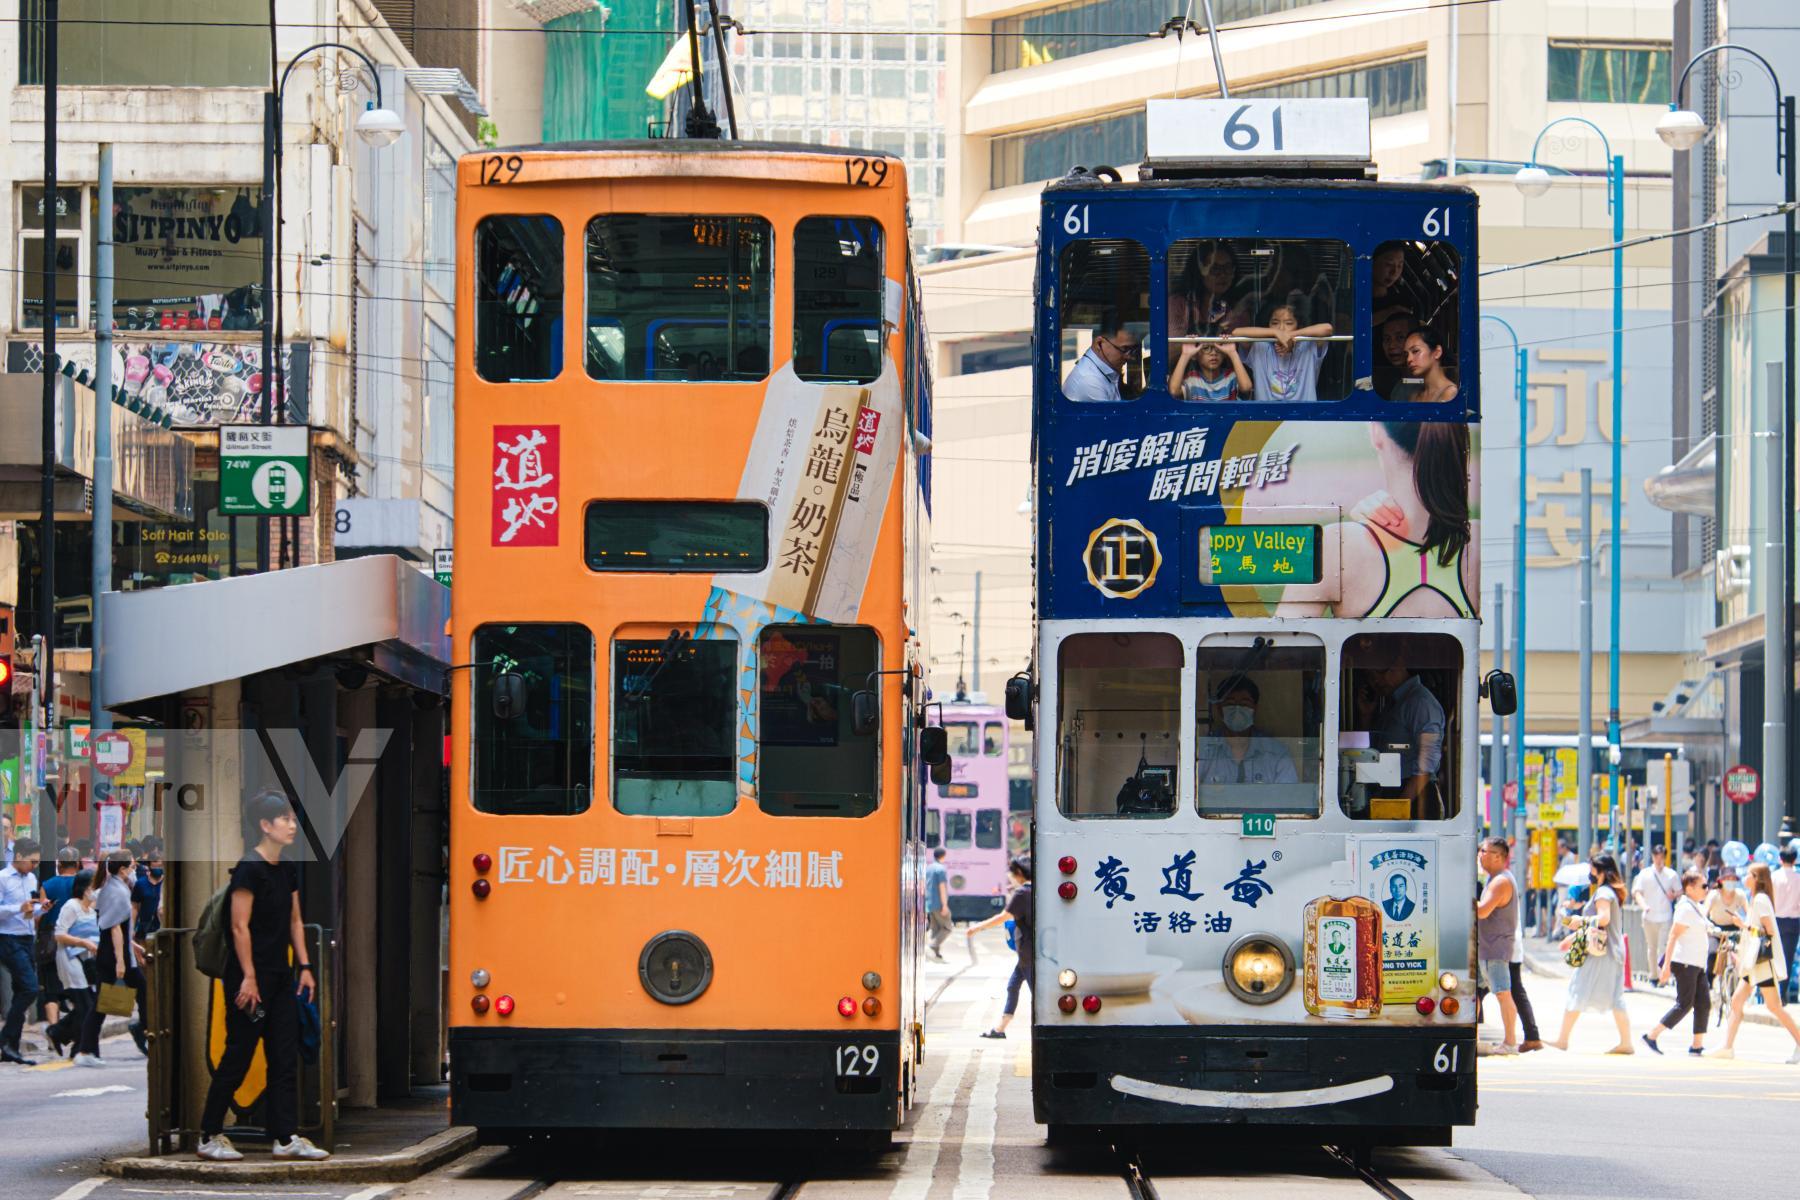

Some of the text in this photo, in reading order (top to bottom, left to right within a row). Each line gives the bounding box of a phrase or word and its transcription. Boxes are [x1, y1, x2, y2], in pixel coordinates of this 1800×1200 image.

[1223, 105, 1284, 151] 61
[481, 155, 523, 185] 129
[845, 158, 888, 187] 129
[116, 212, 242, 244] SITPINYO
[1063, 204, 1089, 234] 61
[1423, 207, 1450, 237] 61
[191, 247, 222, 257] Fitness
[225, 460, 251, 470] 74W
[1149, 442, 1299, 501] 瞬間輕鬆
[141, 528, 230, 541] Soft Hair Salo
[1253, 530, 1306, 554] Valley
[1246, 818, 1273, 832] 110
[1133, 910, 1232, 934] 活絡油
[1396, 961, 1405, 969] TO
[1407, 961, 1422, 969] YICK
[836, 1044, 880, 1077] 129
[1433, 1043, 1458, 1073] 61
